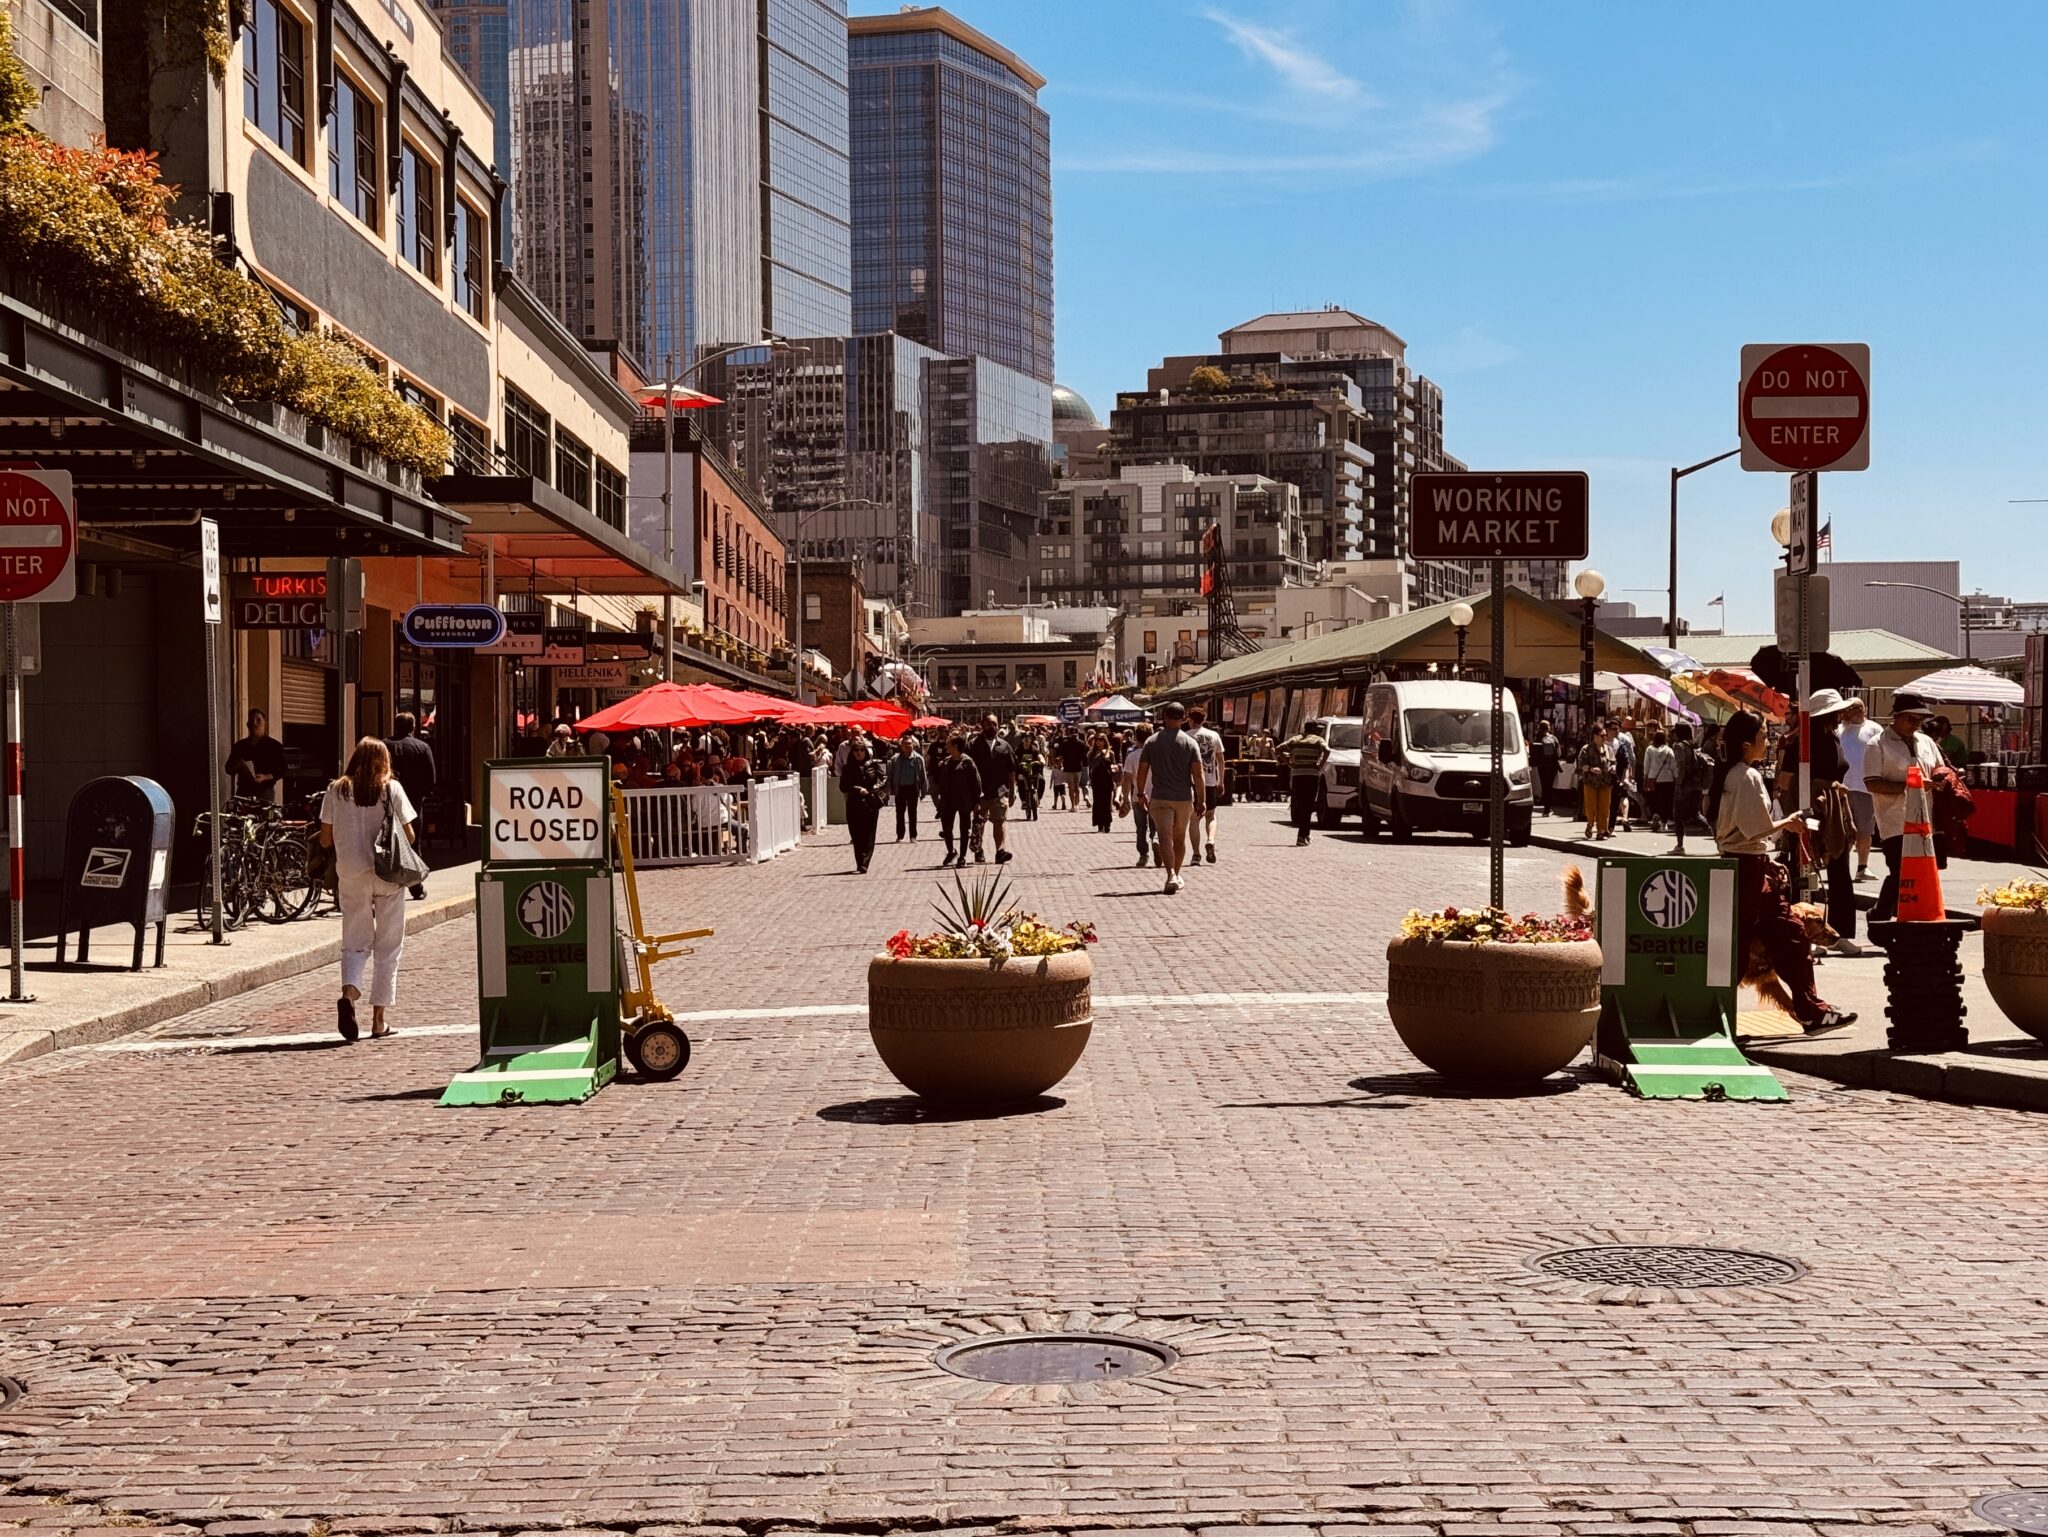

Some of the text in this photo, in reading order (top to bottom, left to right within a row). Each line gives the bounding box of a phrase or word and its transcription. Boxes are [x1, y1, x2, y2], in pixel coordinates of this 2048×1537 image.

[1762, 370, 1849, 389] DO NOT
[1771, 426, 1840, 445] ENTER
[1432, 488, 1562, 512] WORKING
[1793, 480, 1806, 505] ONE
[6, 498, 51, 517] NOT
[1793, 508, 1806, 533] WAY
[205, 529, 216, 551] ONE
[1438, 520, 1560, 544] MARKET
[1, 556, 43, 574] TER
[205, 557, 217, 579] WAY
[252, 577, 327, 595] TURKIS
[414, 615, 493, 630] Pufftown
[558, 668, 622, 678] HELLENIKA
[1115, 712, 1141, 720] Cream
[510, 786, 583, 809] ROAD
[495, 819, 599, 842] CLOSED
[1628, 934, 1707, 954] Seattle
[508, 945, 586, 965] Seattle
